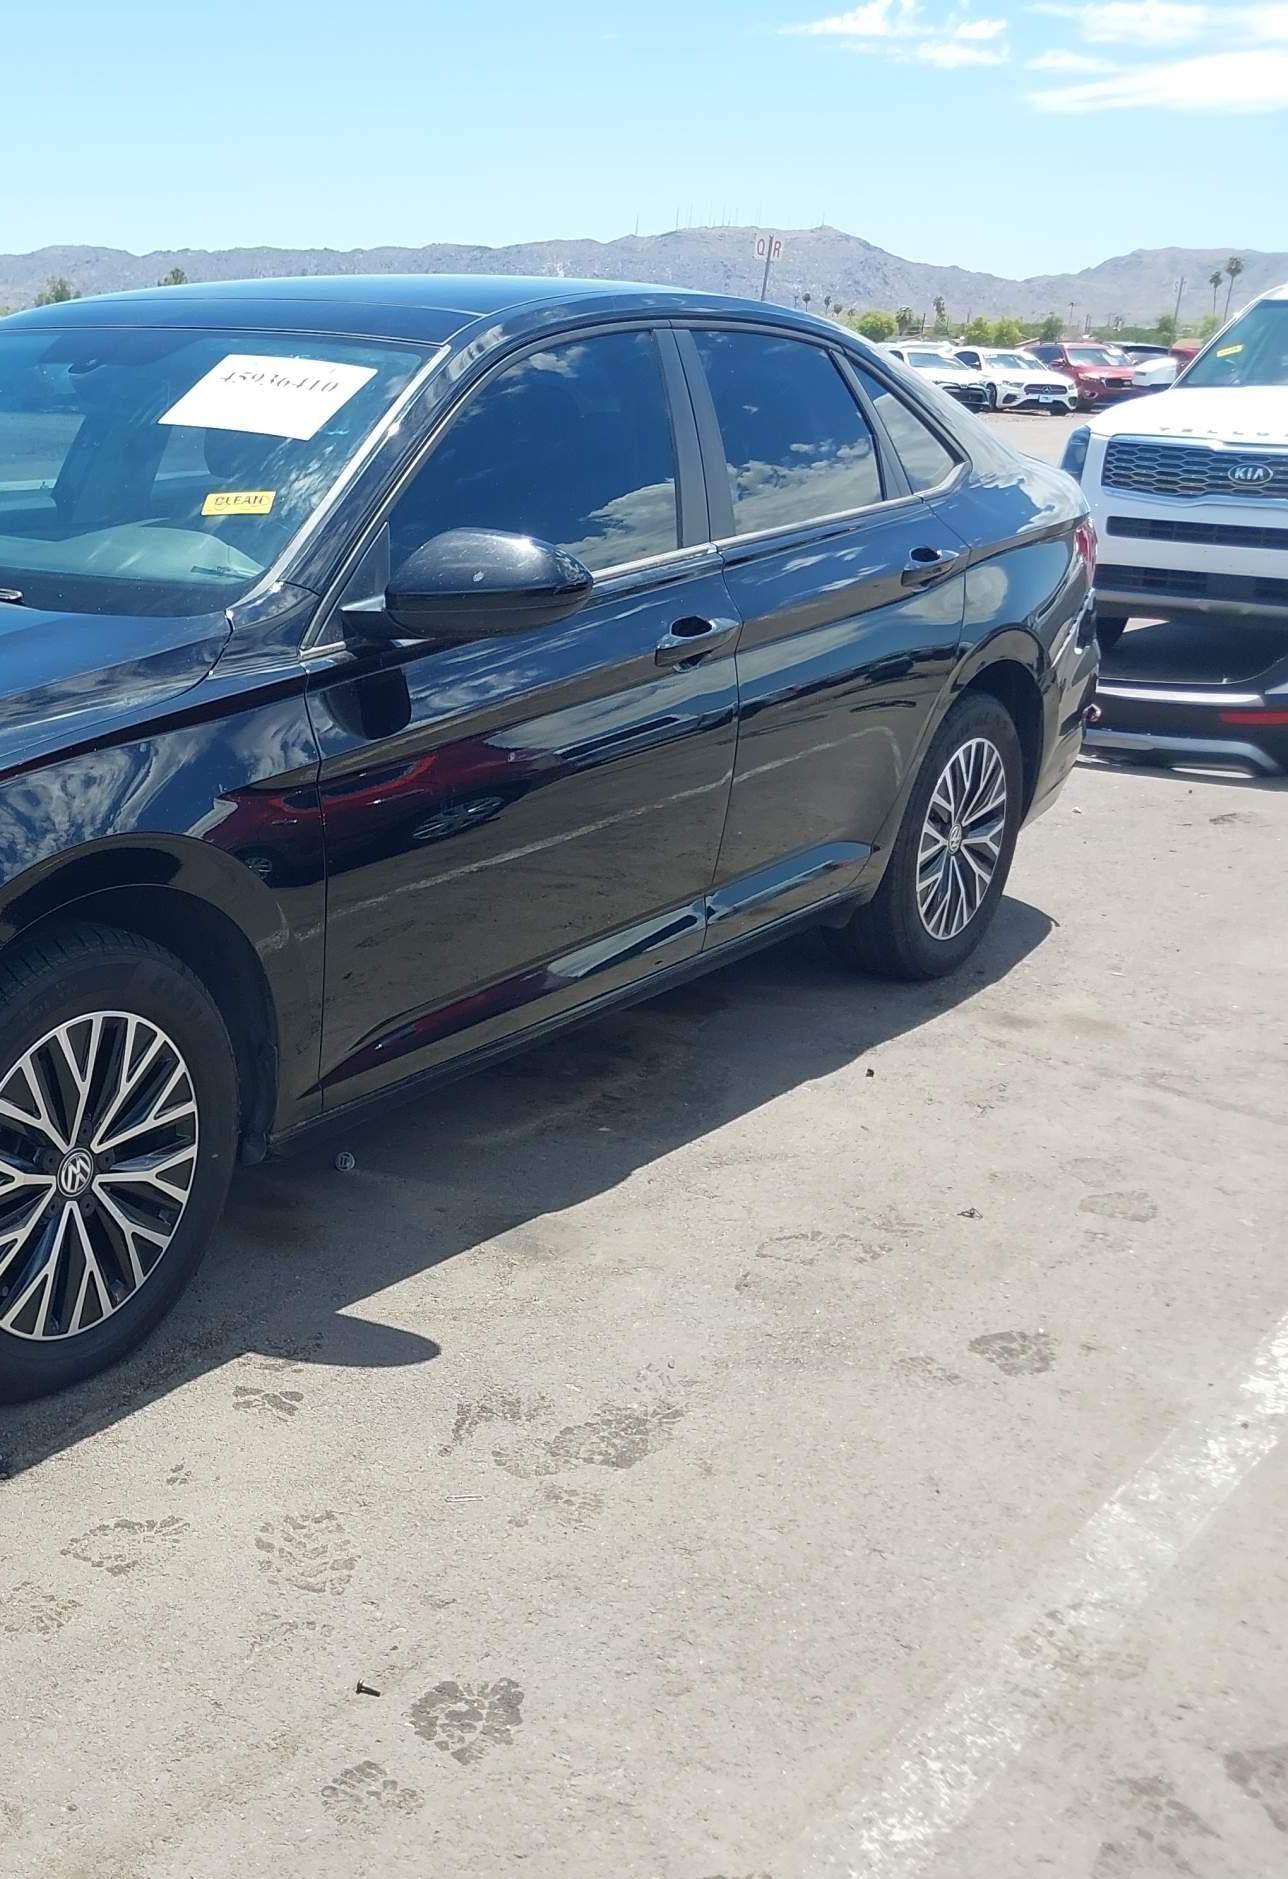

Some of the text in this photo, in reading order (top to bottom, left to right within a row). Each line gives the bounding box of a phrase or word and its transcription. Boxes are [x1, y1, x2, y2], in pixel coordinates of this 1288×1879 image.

[757, 238, 765, 256] Q
[773, 240, 782, 257] R
[1234, 467, 1265, 481] KIA
[214, 494, 265, 506] CLEAN
